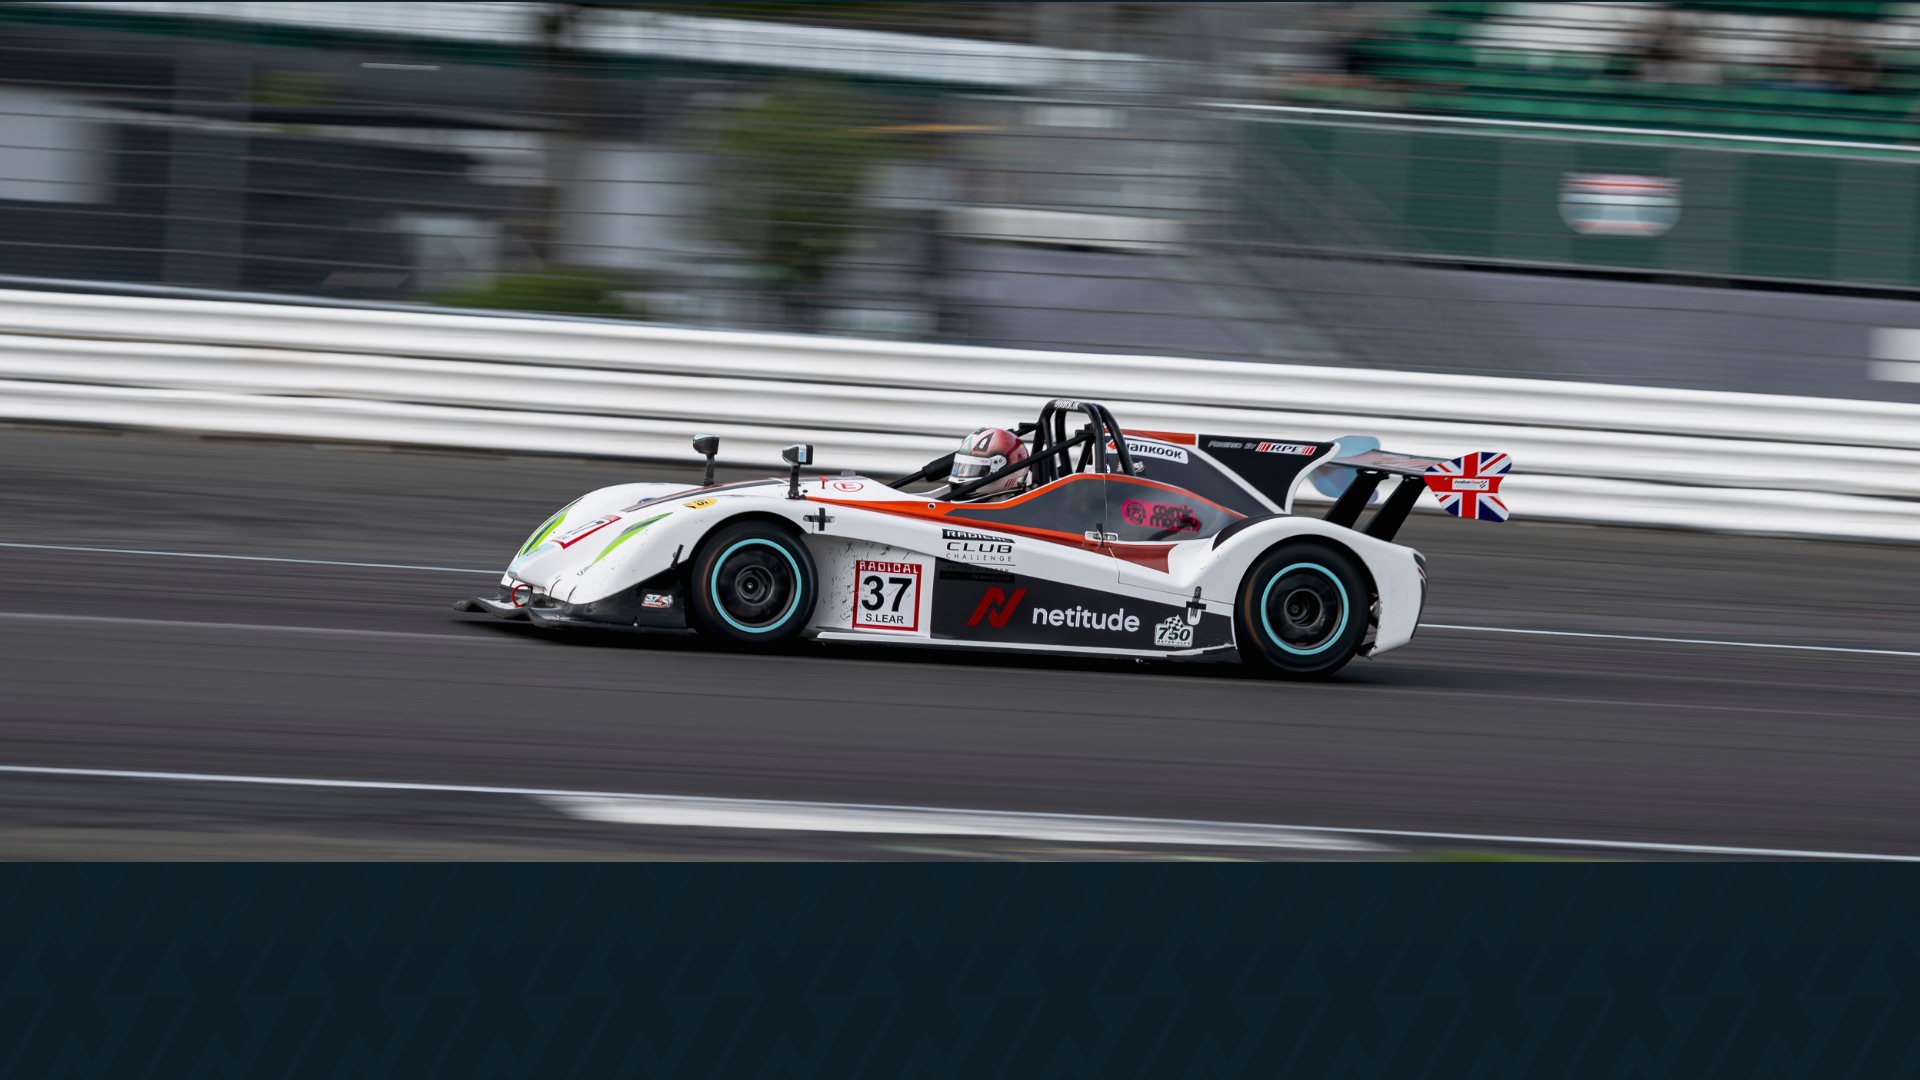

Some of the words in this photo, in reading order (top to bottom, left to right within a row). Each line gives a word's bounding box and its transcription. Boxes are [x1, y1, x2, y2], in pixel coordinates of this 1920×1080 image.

[1270, 444, 1300, 453] RPE
[946, 530, 1011, 542] RADICAL
[946, 541, 1012, 553] CLUB
[946, 552, 1012, 562] CHALLENGE
[860, 561, 918, 574] RADICAL
[862, 575, 912, 612] 37
[865, 613, 904, 624] S.LEAR
[1032, 605, 1140, 632] netitude
[1158, 626, 1191, 641] 750
